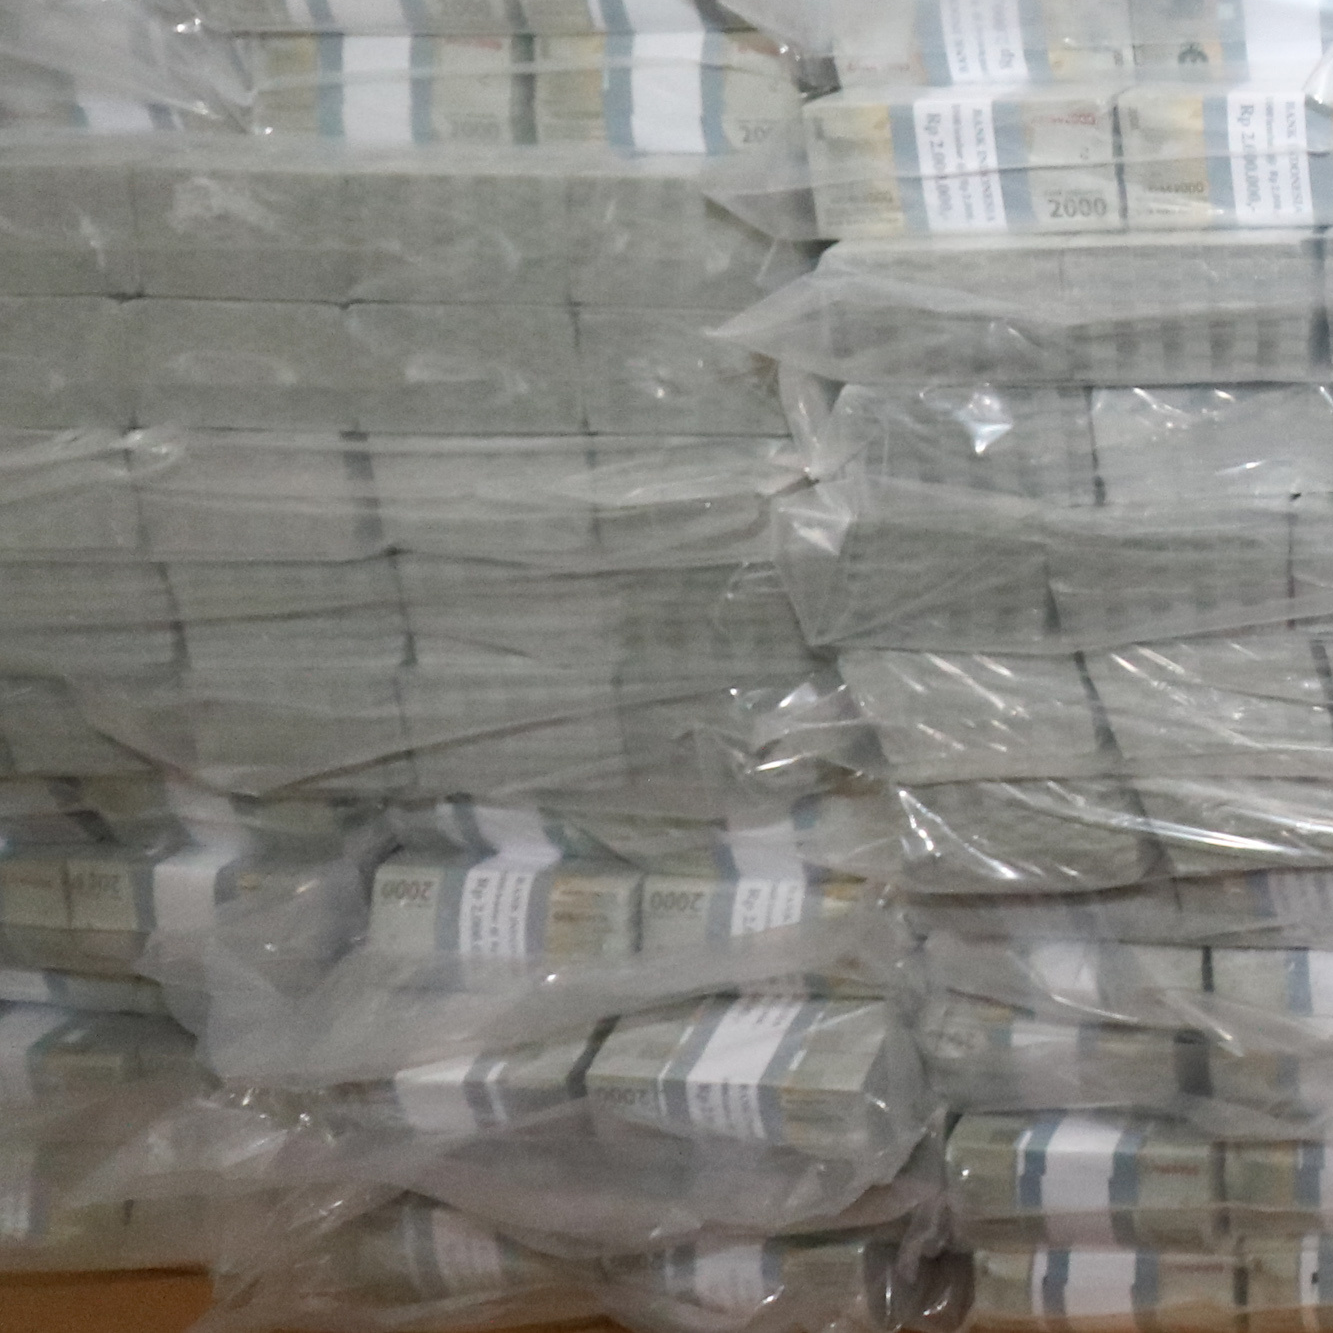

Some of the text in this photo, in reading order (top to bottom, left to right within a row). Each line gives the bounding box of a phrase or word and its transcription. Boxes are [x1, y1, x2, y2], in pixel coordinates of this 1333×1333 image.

[1237, 104, 1254, 127] Rp
[1285, 101, 1297, 139] BANK
[1047, 197, 1108, 218] 2000
